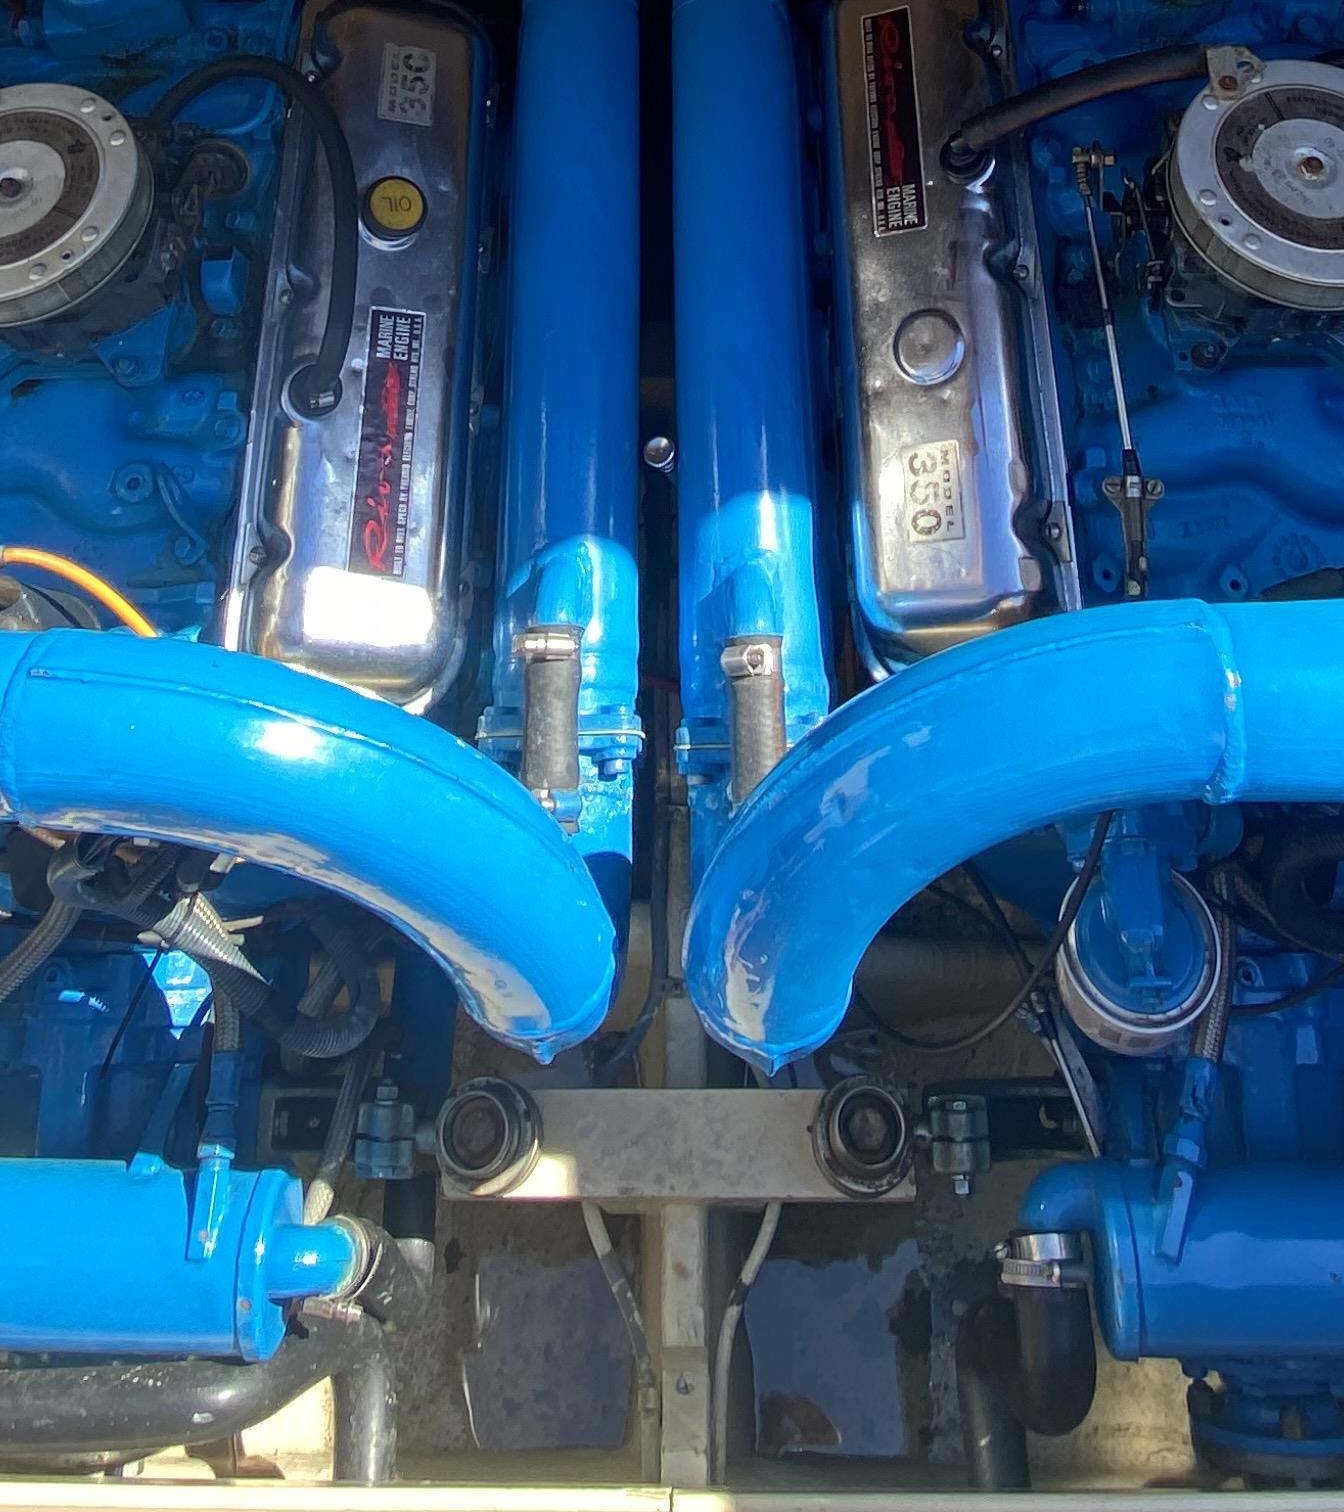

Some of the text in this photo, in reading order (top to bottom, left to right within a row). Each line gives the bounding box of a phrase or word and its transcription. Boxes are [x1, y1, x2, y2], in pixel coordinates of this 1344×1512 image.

[382, 196, 412, 213] OIL
[886, 186, 903, 230] ENGINE
[902, 184, 918, 226] MARINE
[376, 314, 394, 359] MARINE
[394, 316, 411, 361] ENGINE
[908, 452, 942, 536] 350
[940, 449, 954, 532] MODEL
